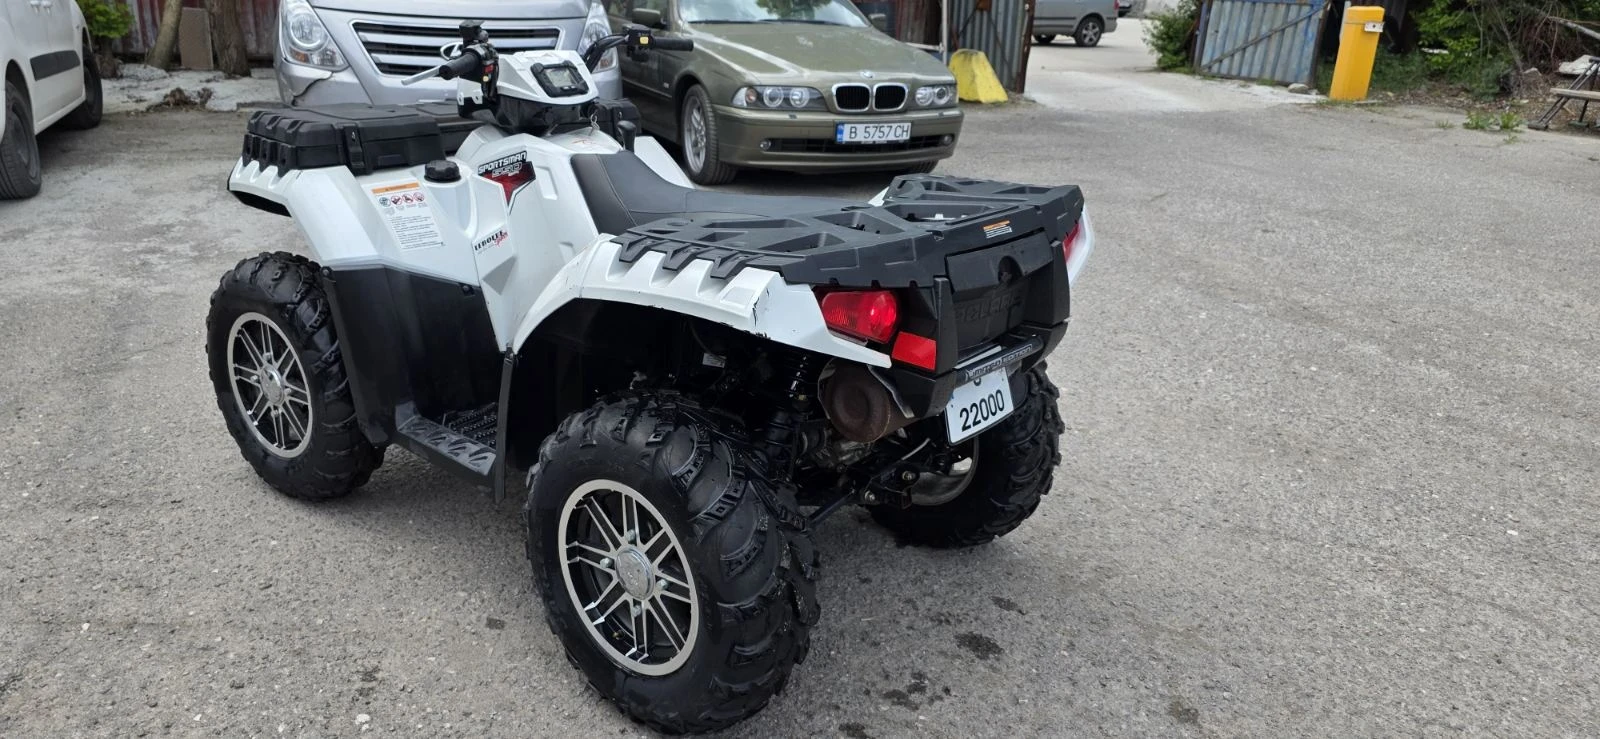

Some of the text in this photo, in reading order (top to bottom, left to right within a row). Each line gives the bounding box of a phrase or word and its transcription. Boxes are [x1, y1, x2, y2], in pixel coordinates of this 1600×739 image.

[849, 126, 858, 140] B
[863, 125, 893, 140] 5757
[894, 124, 910, 138] CH
[478, 151, 527, 174] SPORTSMAN
[959, 389, 1005, 433] 22000
